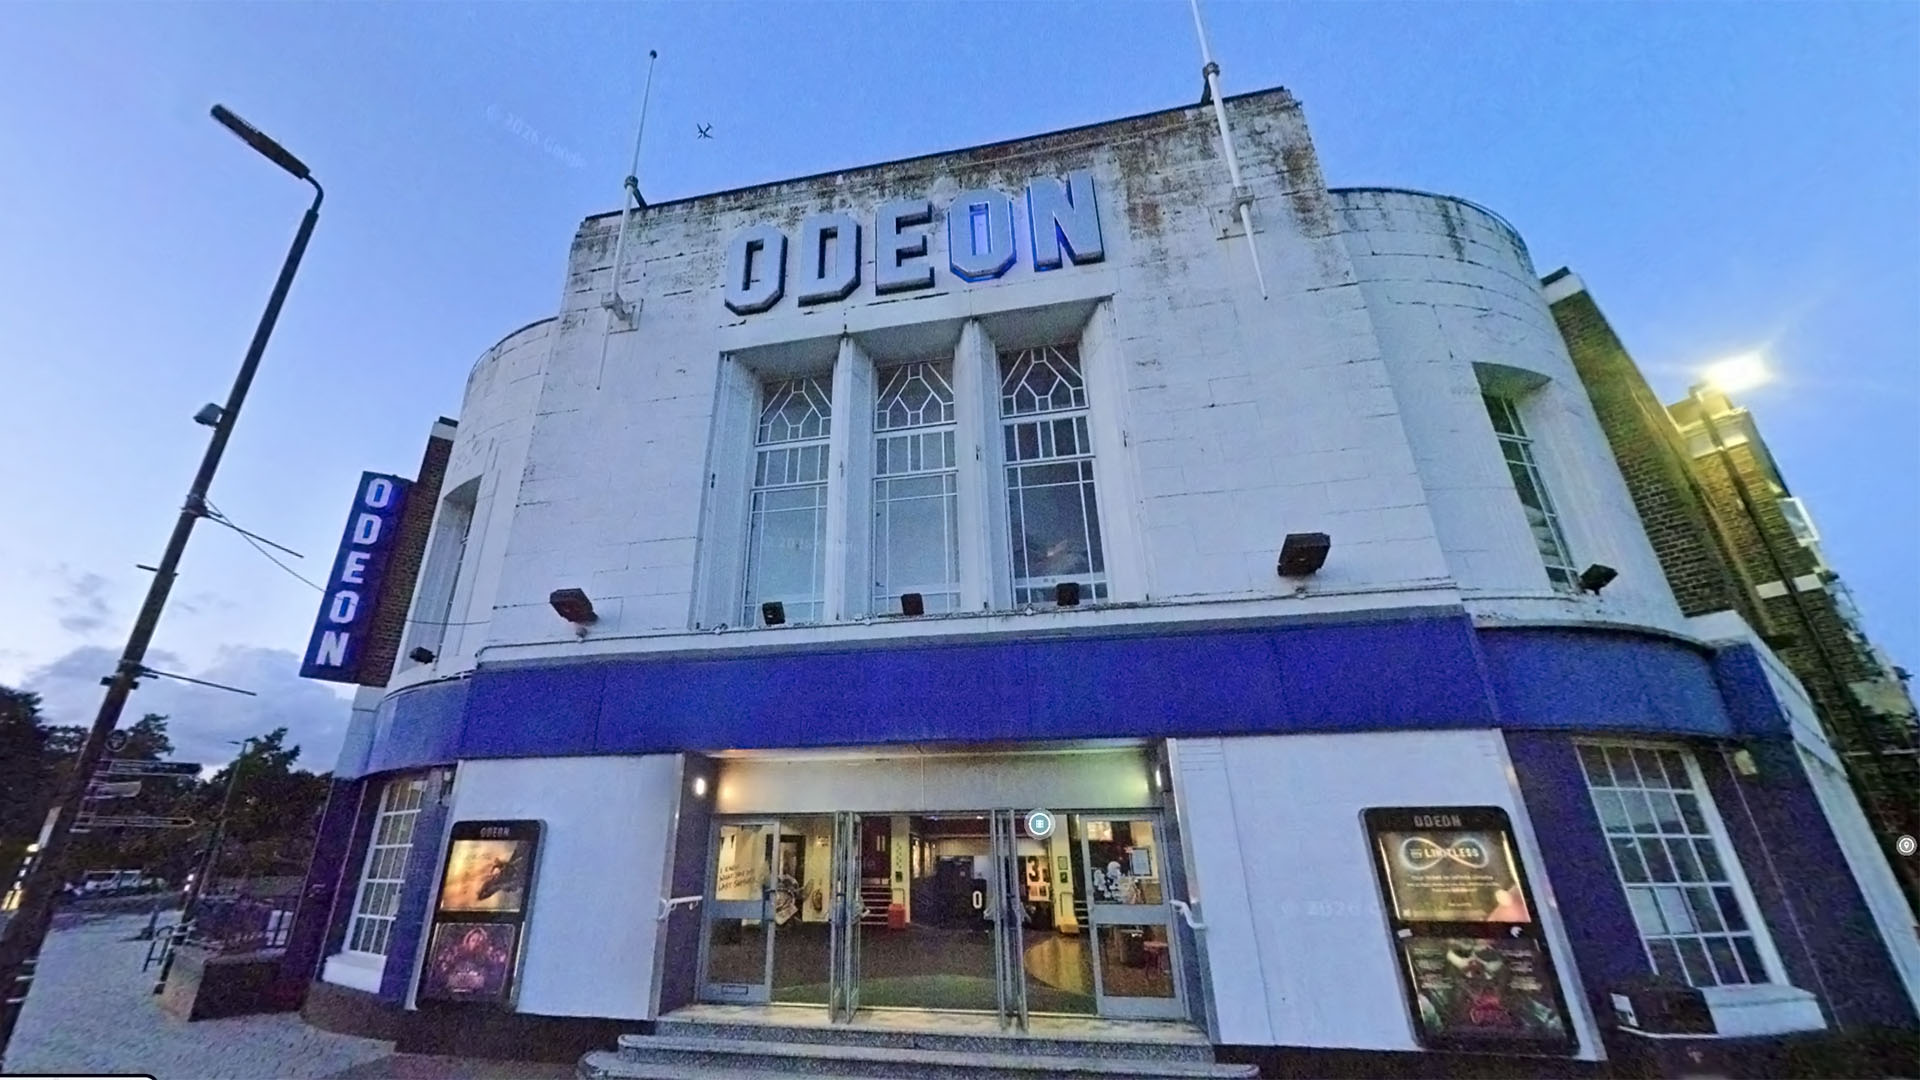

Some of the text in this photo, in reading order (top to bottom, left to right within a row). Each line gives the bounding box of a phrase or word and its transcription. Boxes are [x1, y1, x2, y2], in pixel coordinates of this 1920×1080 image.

[724, 170, 1105, 316] ODEON
[315, 477, 393, 667] ODEON
[480, 826, 511, 838] ODEON
[1412, 815, 1463, 828] ODEON
